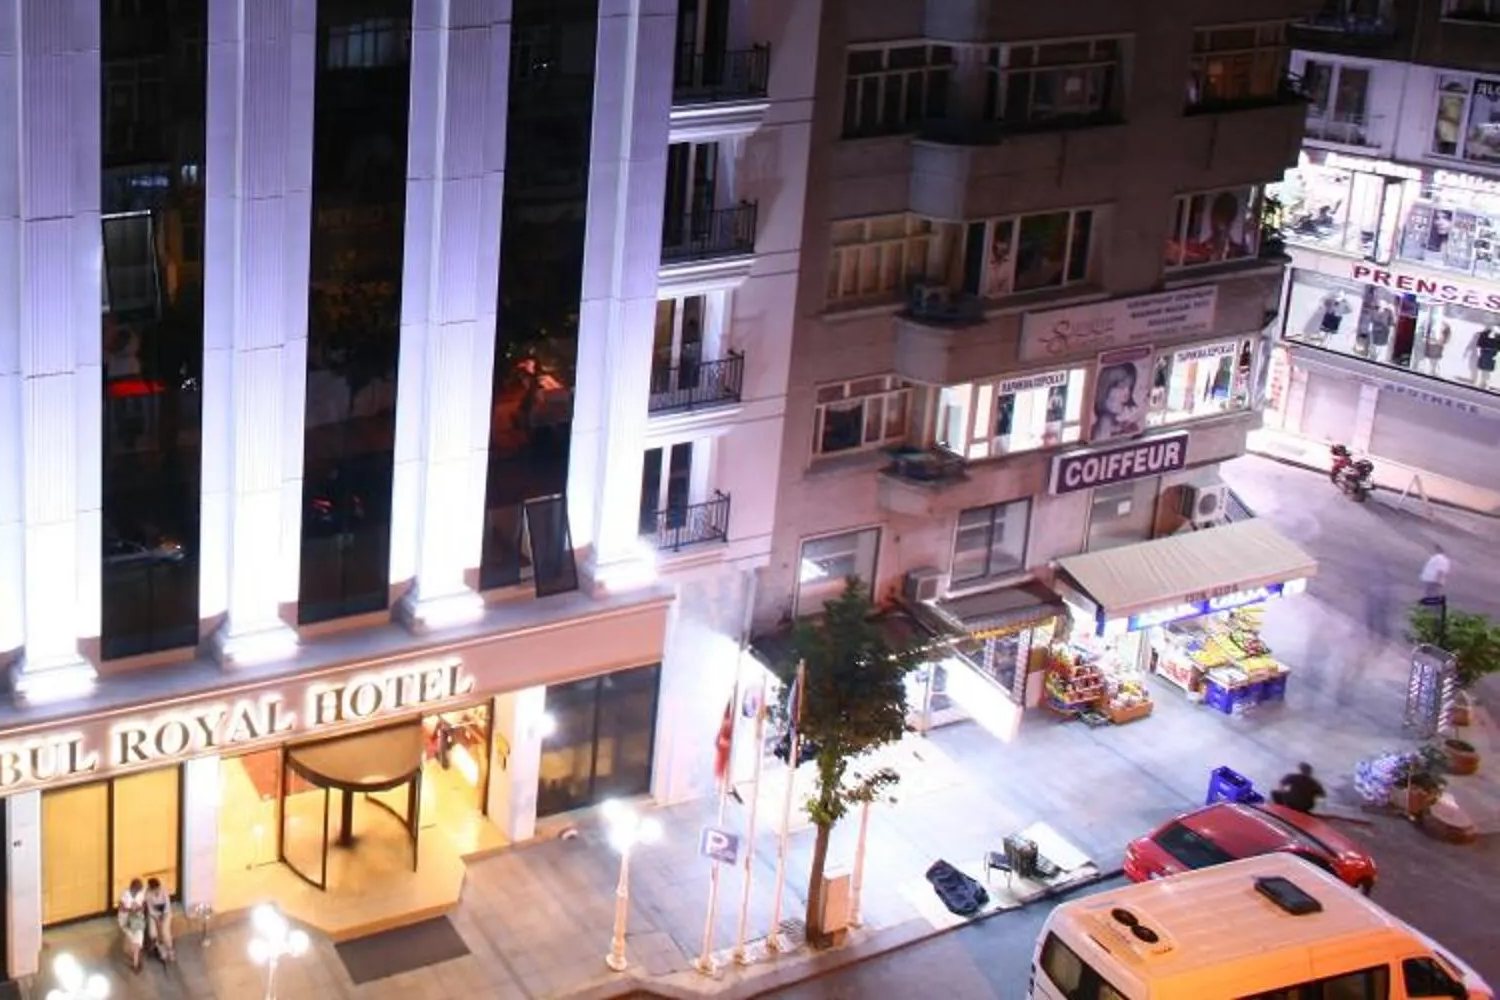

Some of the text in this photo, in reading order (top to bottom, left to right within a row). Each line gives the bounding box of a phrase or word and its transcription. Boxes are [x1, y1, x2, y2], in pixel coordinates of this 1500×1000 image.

[1353, 264, 1500, 310] PRENSES
[1065, 440, 1181, 487] COIFFEUR
[114, 698, 294, 767] ROYAL
[311, 660, 474, 725] HOTEL
[705, 829, 730, 855] P
